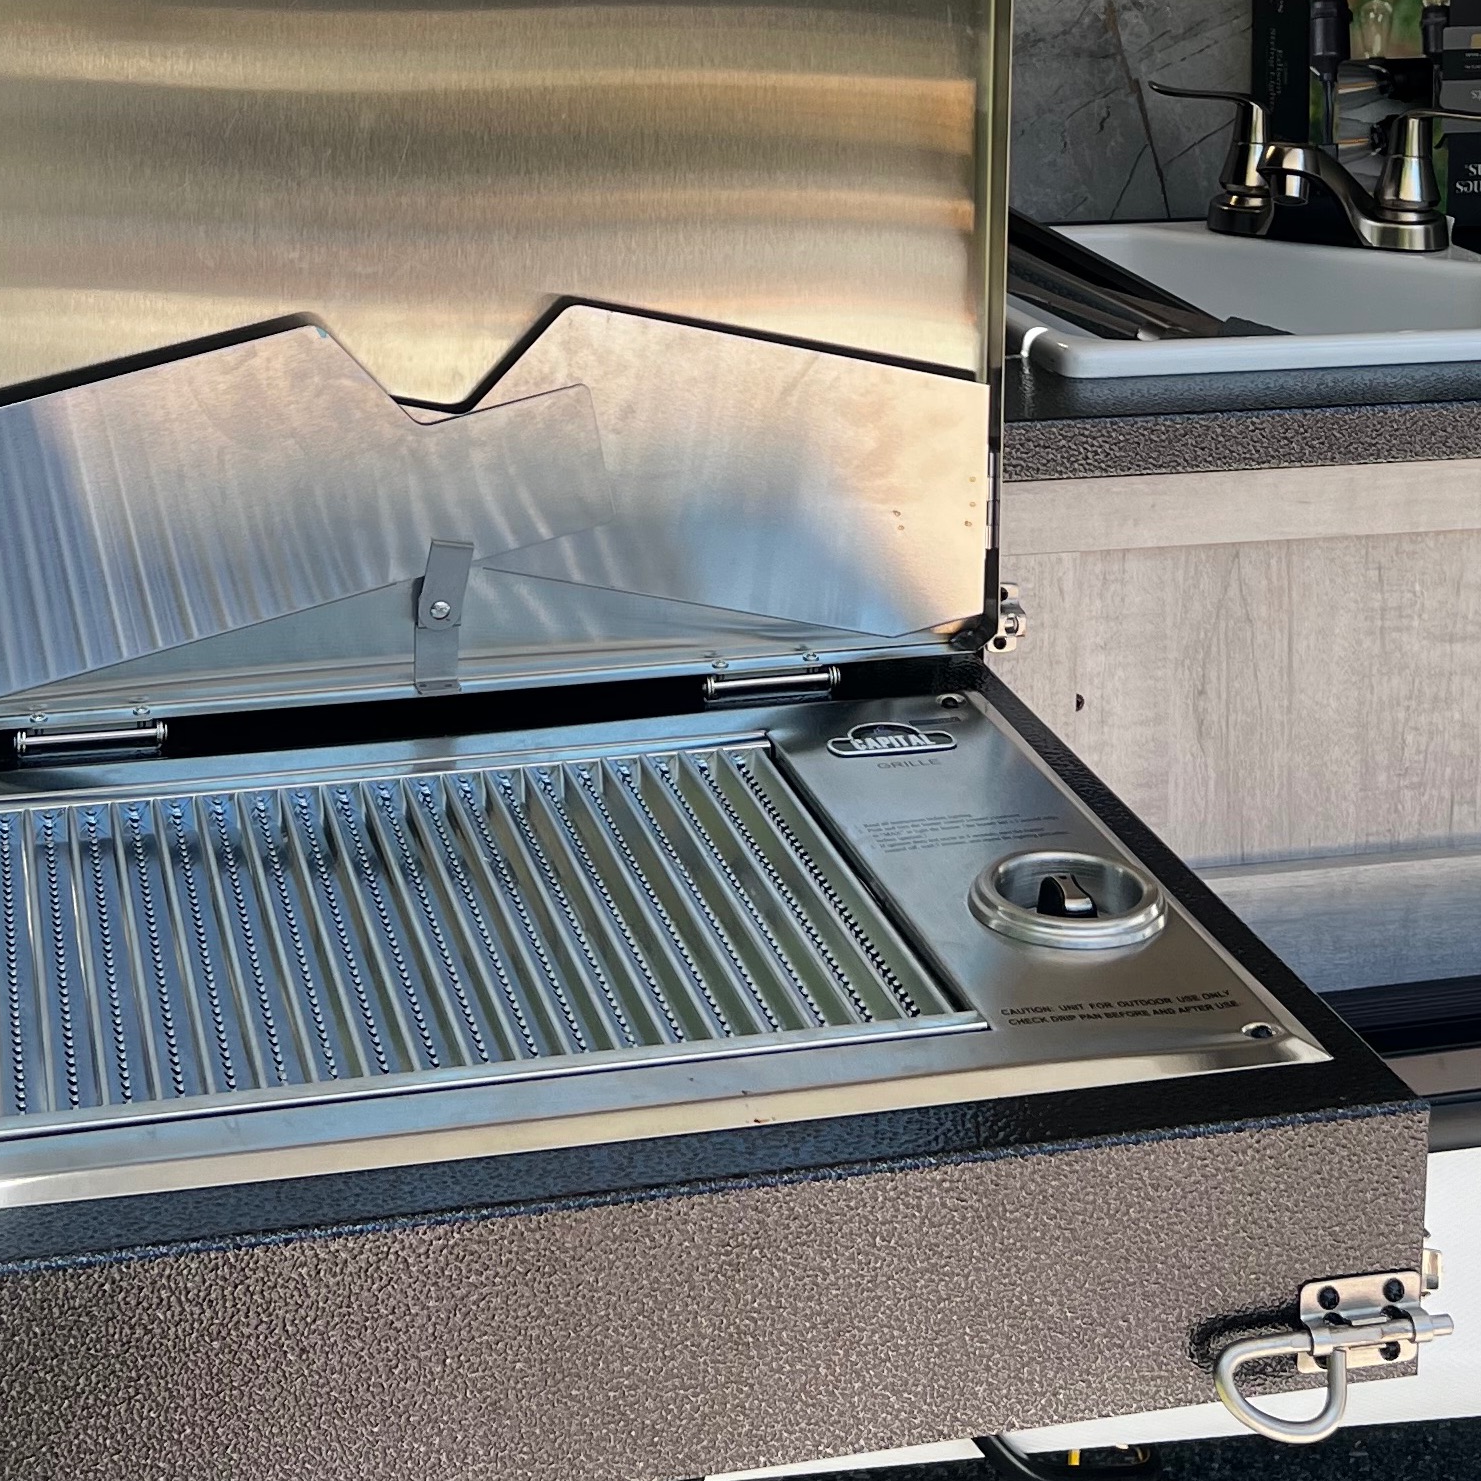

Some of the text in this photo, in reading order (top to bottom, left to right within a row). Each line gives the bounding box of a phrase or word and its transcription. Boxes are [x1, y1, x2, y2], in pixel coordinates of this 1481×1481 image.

[850, 733, 936, 750] CAPITAL
[877, 758, 942, 769] GRILLE
[1000, 989, 1231, 1016] CAUTION: UNIT FOR OUTDOOR USE ONLY
[1008, 1016, 1048, 1026] CHECK
[1050, 1014, 1076, 1024] DRIP
[1079, 1013, 1103, 1021] PAN
[1104, 1009, 1152, 1019] BEFORE
[1152, 1007, 1176, 1016] AND
[1178, 1004, 1214, 1014] AFTER
